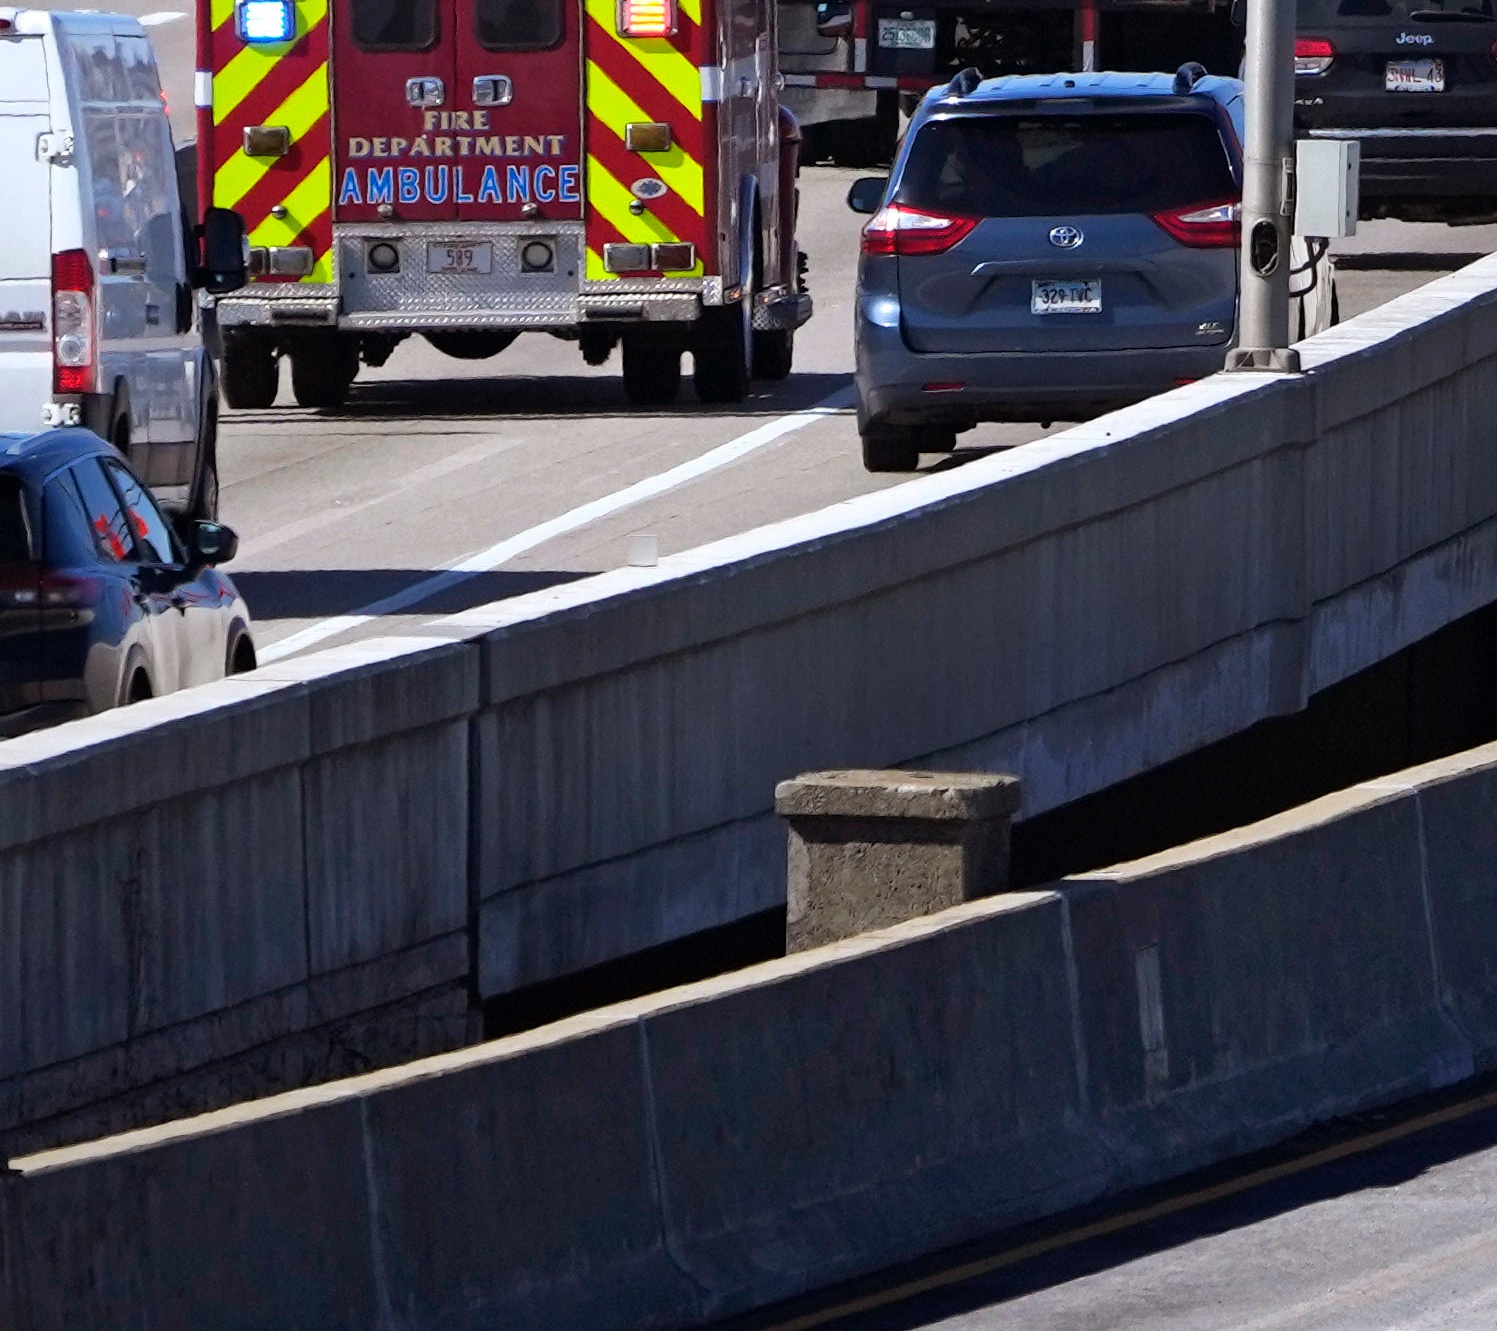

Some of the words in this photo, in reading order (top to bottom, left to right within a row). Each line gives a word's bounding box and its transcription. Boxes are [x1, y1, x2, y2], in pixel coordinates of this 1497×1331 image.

[1395, 31, 1435, 46] Jeep
[423, 110, 490, 131] FIRE
[348, 134, 566, 158] DEPARTMENT
[338, 165, 580, 204] AMBULANCE
